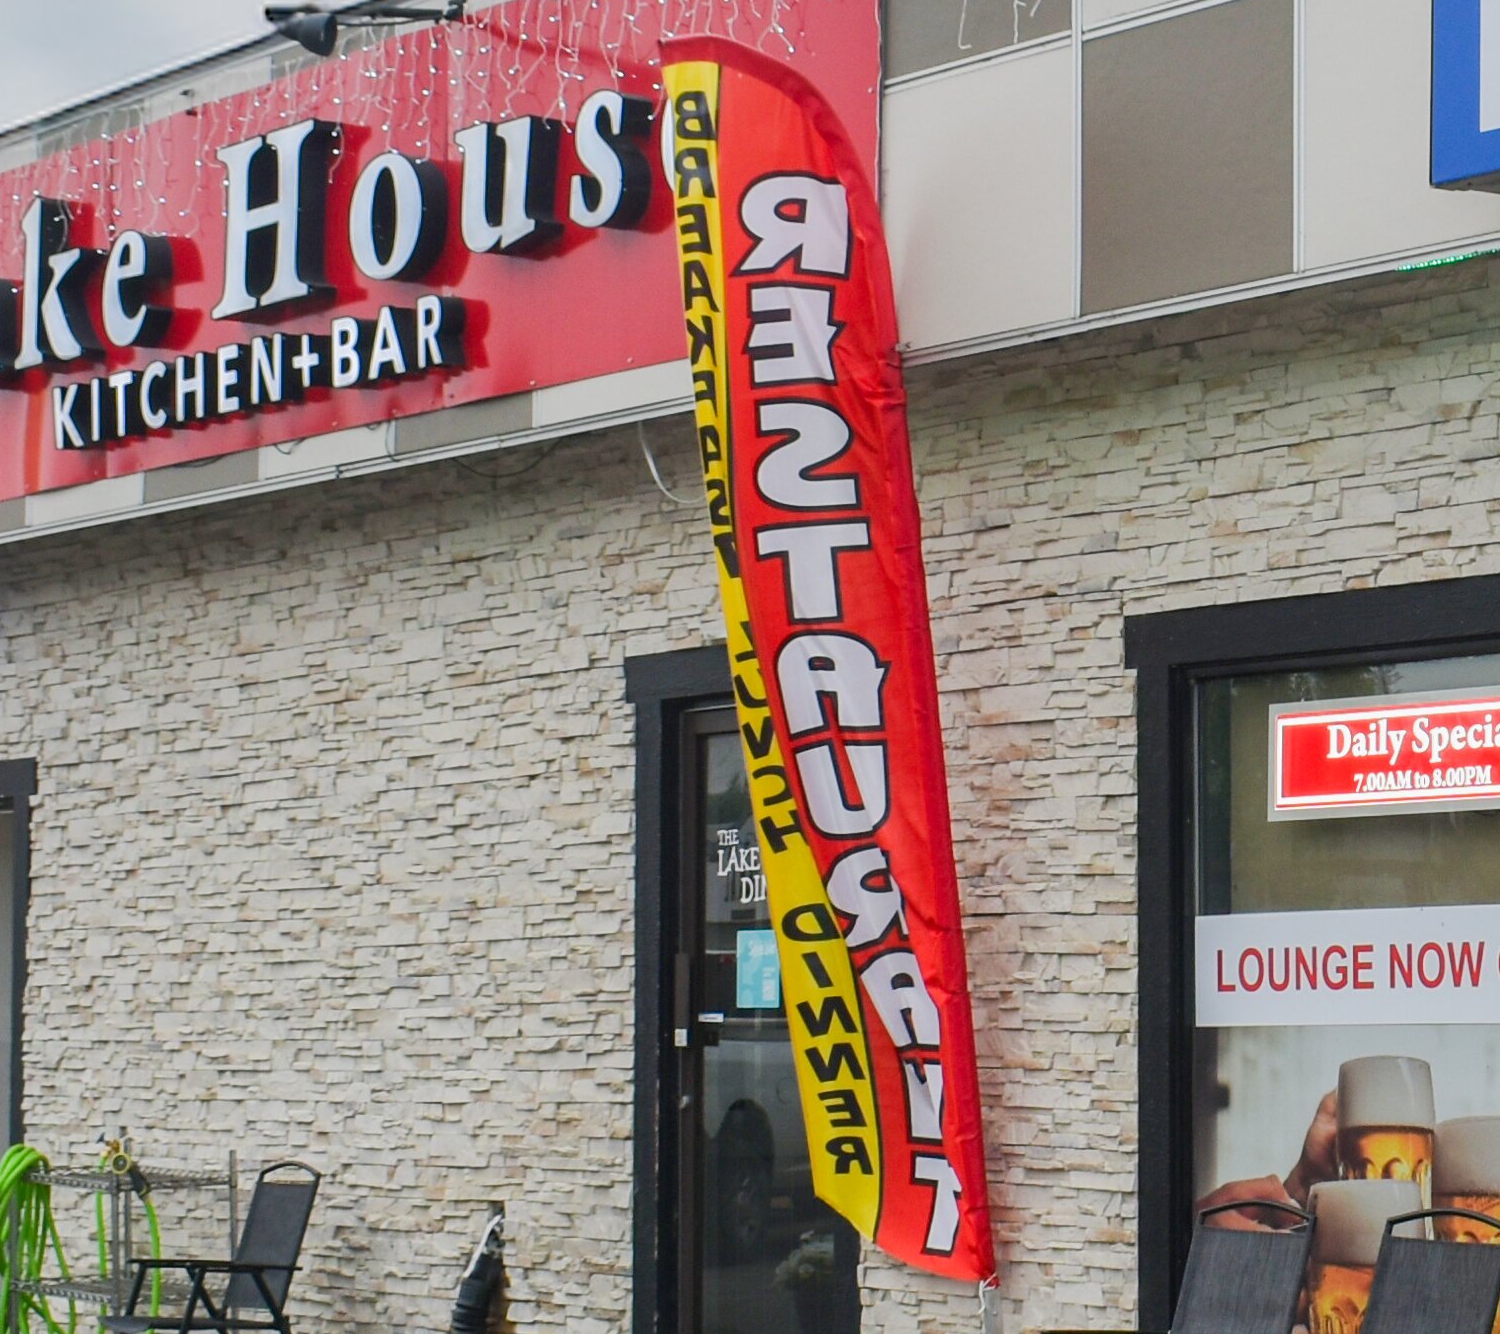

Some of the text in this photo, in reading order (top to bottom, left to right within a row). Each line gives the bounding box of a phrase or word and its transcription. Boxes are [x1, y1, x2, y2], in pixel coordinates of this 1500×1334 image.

[211, 90, 675, 322] Hous
[51, 294, 446, 452] KITCHEN+BAR
[1326, 718, 1406, 765] Daily
[1353, 764, 1492, 793] 7.00AM to 8.00PM
[716, 829, 740, 846] THE
[716, 845, 761, 877] LAKE
[1215, 943, 1375, 993] LOUNGE
[1389, 940, 1486, 990] NOW
